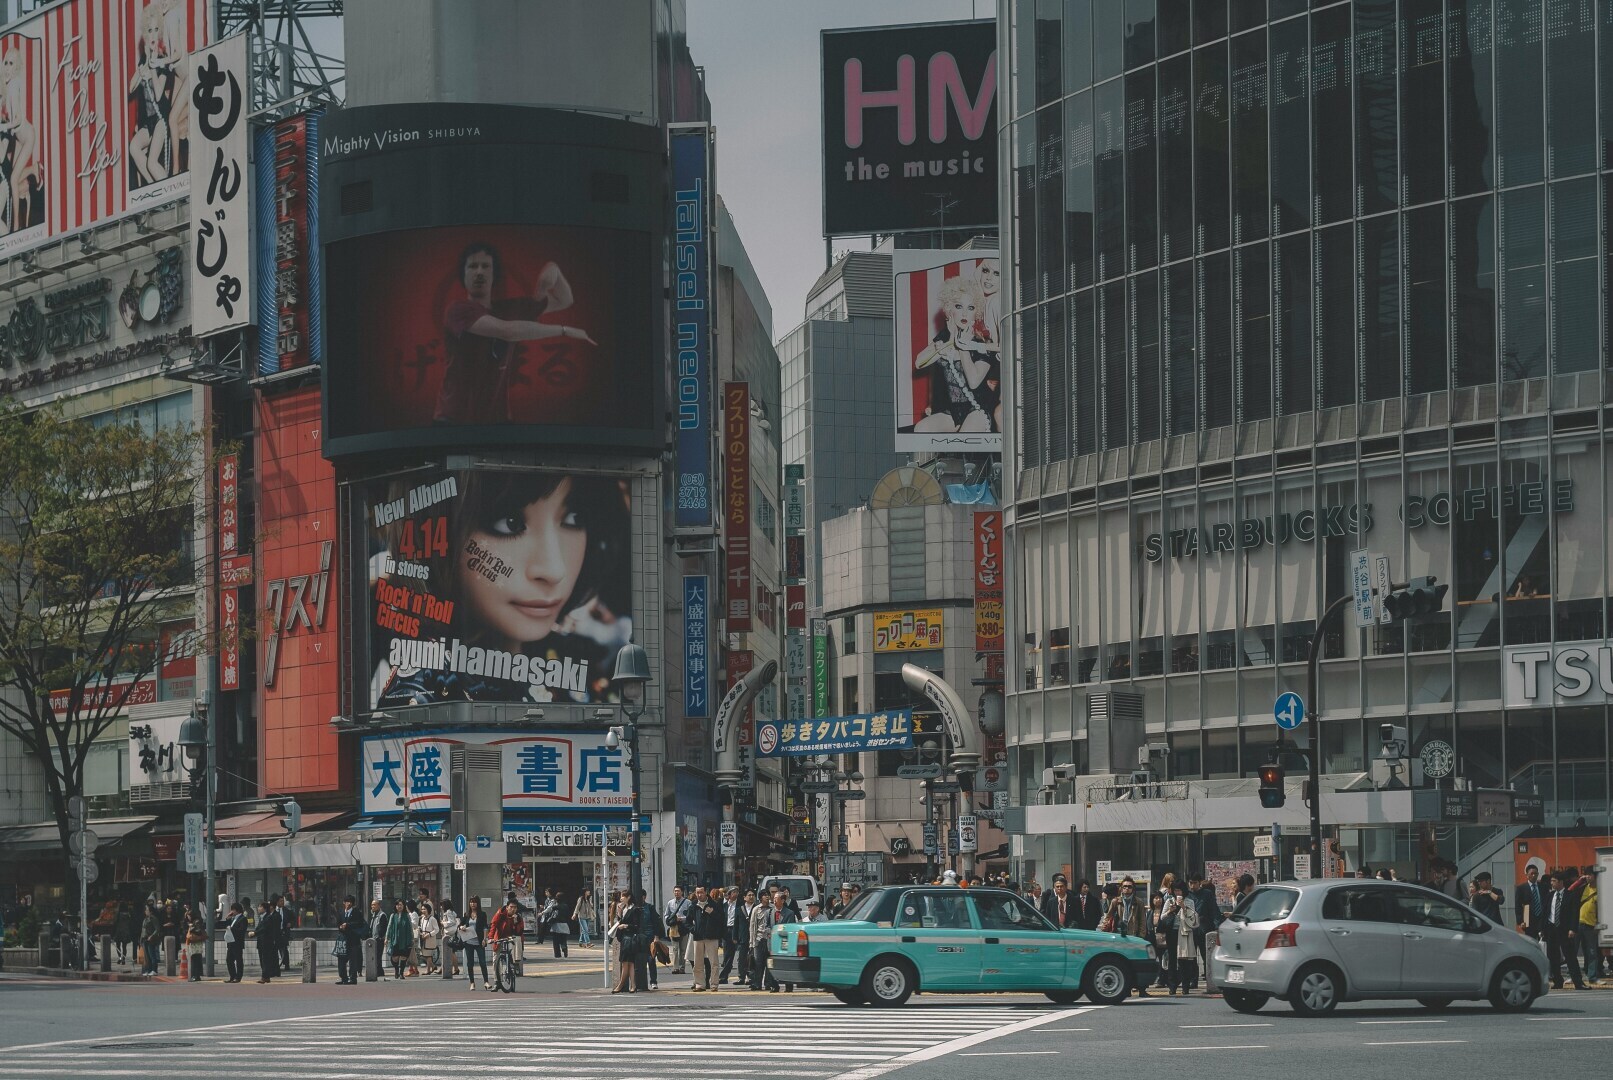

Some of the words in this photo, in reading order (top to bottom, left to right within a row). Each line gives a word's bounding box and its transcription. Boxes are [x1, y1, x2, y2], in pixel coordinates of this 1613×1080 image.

[52, 36, 100, 92] From
[67, 87, 97, 133] Our
[77, 121, 120, 192] Lips
[324, 136, 370, 157] Mighty
[374, 129, 420, 150] Vision
[428, 127, 480, 139] SHIBUYA
[844, 157, 890, 181] the
[903, 150, 984, 178] music
[131, 187, 163, 204] MAC
[193, 54, 242, 319] もんじゃ
[676, 178, 704, 311] Taisei
[678, 322, 700, 429] neon
[730, 389, 745, 524] クスリのことなら
[679, 487, 706, 497] 3719
[681, 473, 704, 485] (03)
[374, 498, 404, 528] New
[409, 475, 457, 514] Album
[679, 498, 706, 508] 2468
[1144, 502, 1375, 562] STARBUCKS
[1398, 478, 1573, 530] COFFEE
[400, 516, 448, 560] 4.14
[466, 538, 514, 578] Rock'n'Roll
[398, 560, 430, 580] stores
[467, 557, 499, 583] Circus
[729, 536, 749, 619] 三千里
[1353, 566, 1361, 597] Shibuya
[1358, 555, 1373, 620] 渋谷駅前
[263, 540, 333, 686] クスリ
[376, 578, 454, 624] Rock'n'Roll
[376, 604, 420, 638] Circus
[788, 602, 803, 612] JTB
[980, 611, 1000, 620] 140g
[688, 586, 705, 708] 大盛堂商事ビル
[877, 619, 940, 647] フリー麻雀
[389, 637, 446, 671] ayumi
[450, 638, 588, 693] hamasaki
[715, 683, 745, 749] 渋谷センター街
[781, 713, 909, 743] 歩きタバコ禁止
[865, 736, 908, 747] 渋谷センター街
[1421, 741, 1453, 758] STARBUCKS
[1424, 766, 1450, 777] COFFEE
[579, 796, 600, 805] BOOKS
[603, 796, 633, 805] TAISEIDO
[188, 818, 197, 863] 文化村通り
